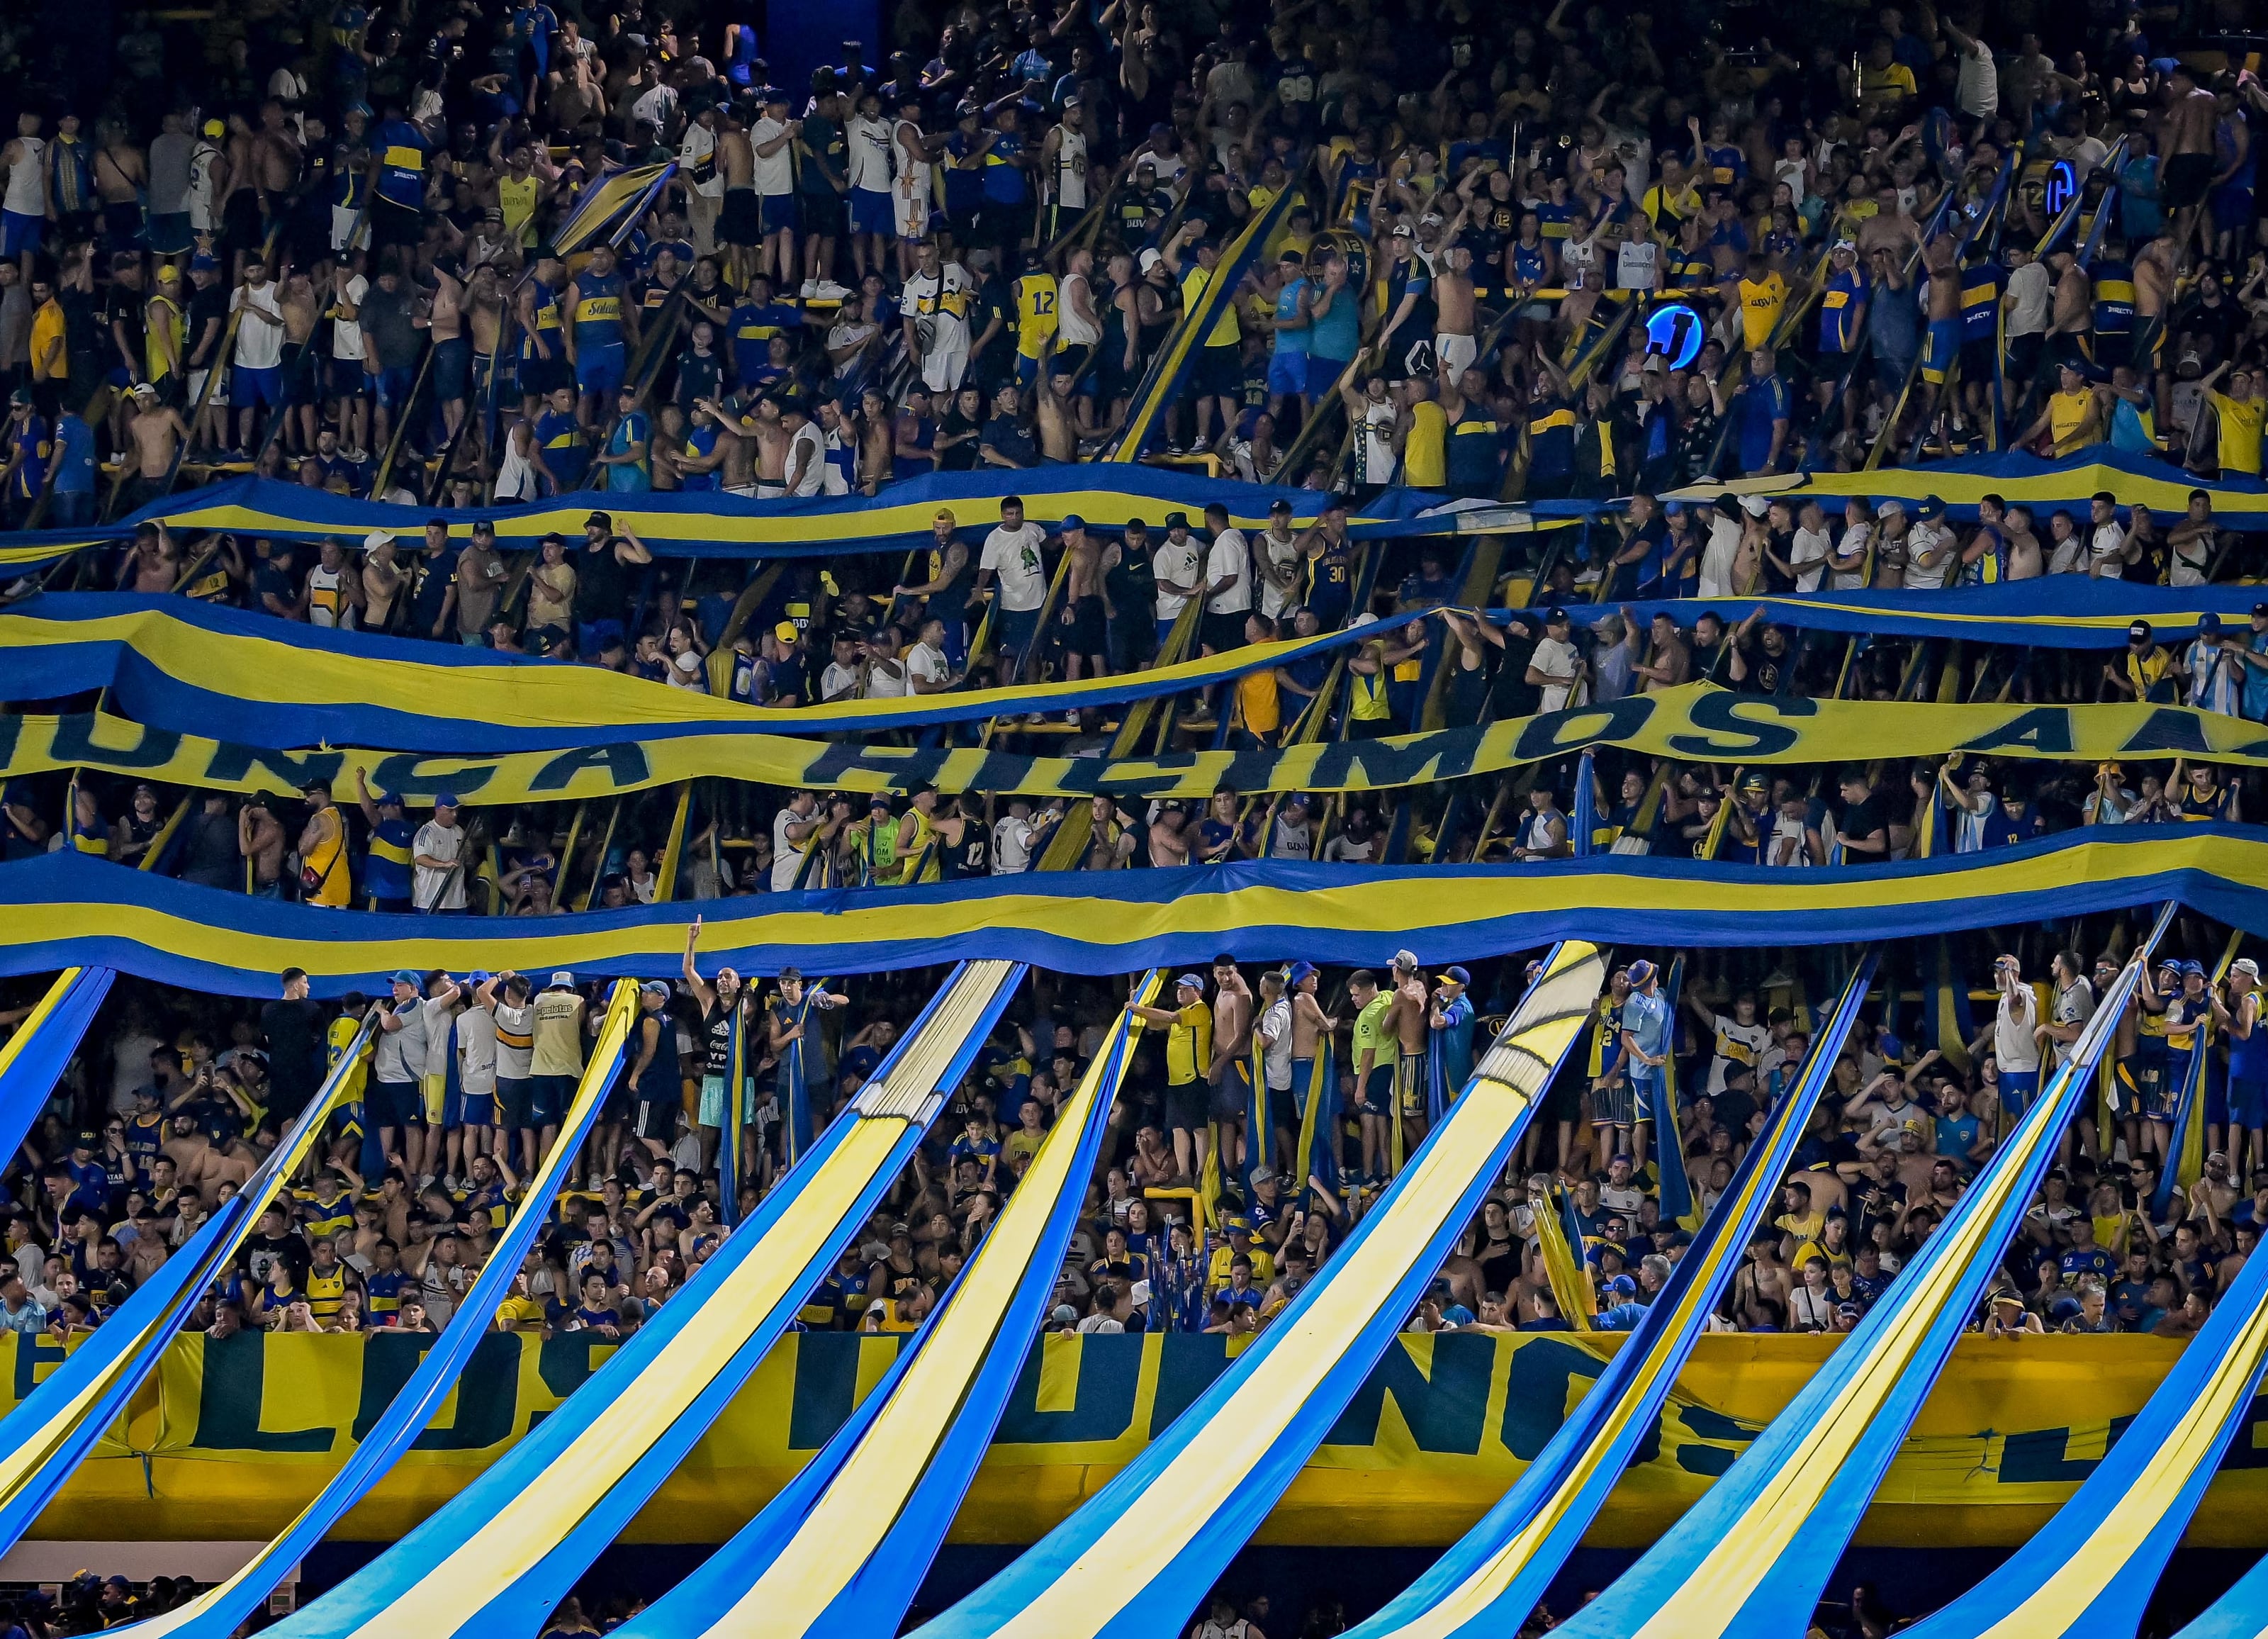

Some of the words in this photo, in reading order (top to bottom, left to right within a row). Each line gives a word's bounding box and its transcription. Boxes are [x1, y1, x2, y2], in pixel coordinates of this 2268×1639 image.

[1126, 219, 1147, 229] BBV
[1033, 291, 1055, 315] 12
[1751, 297, 1778, 308] BBVA
[2108, 306, 2133, 315] DIRECTV
[1329, 565, 1345, 581] 30
[2007, 833, 2019, 844] 12
[967, 841, 985, 866] 12
[541, 1003, 573, 1016] pelotas
[710, 1051, 727, 1061] YP
[2064, 1257, 2073, 1268] 12
